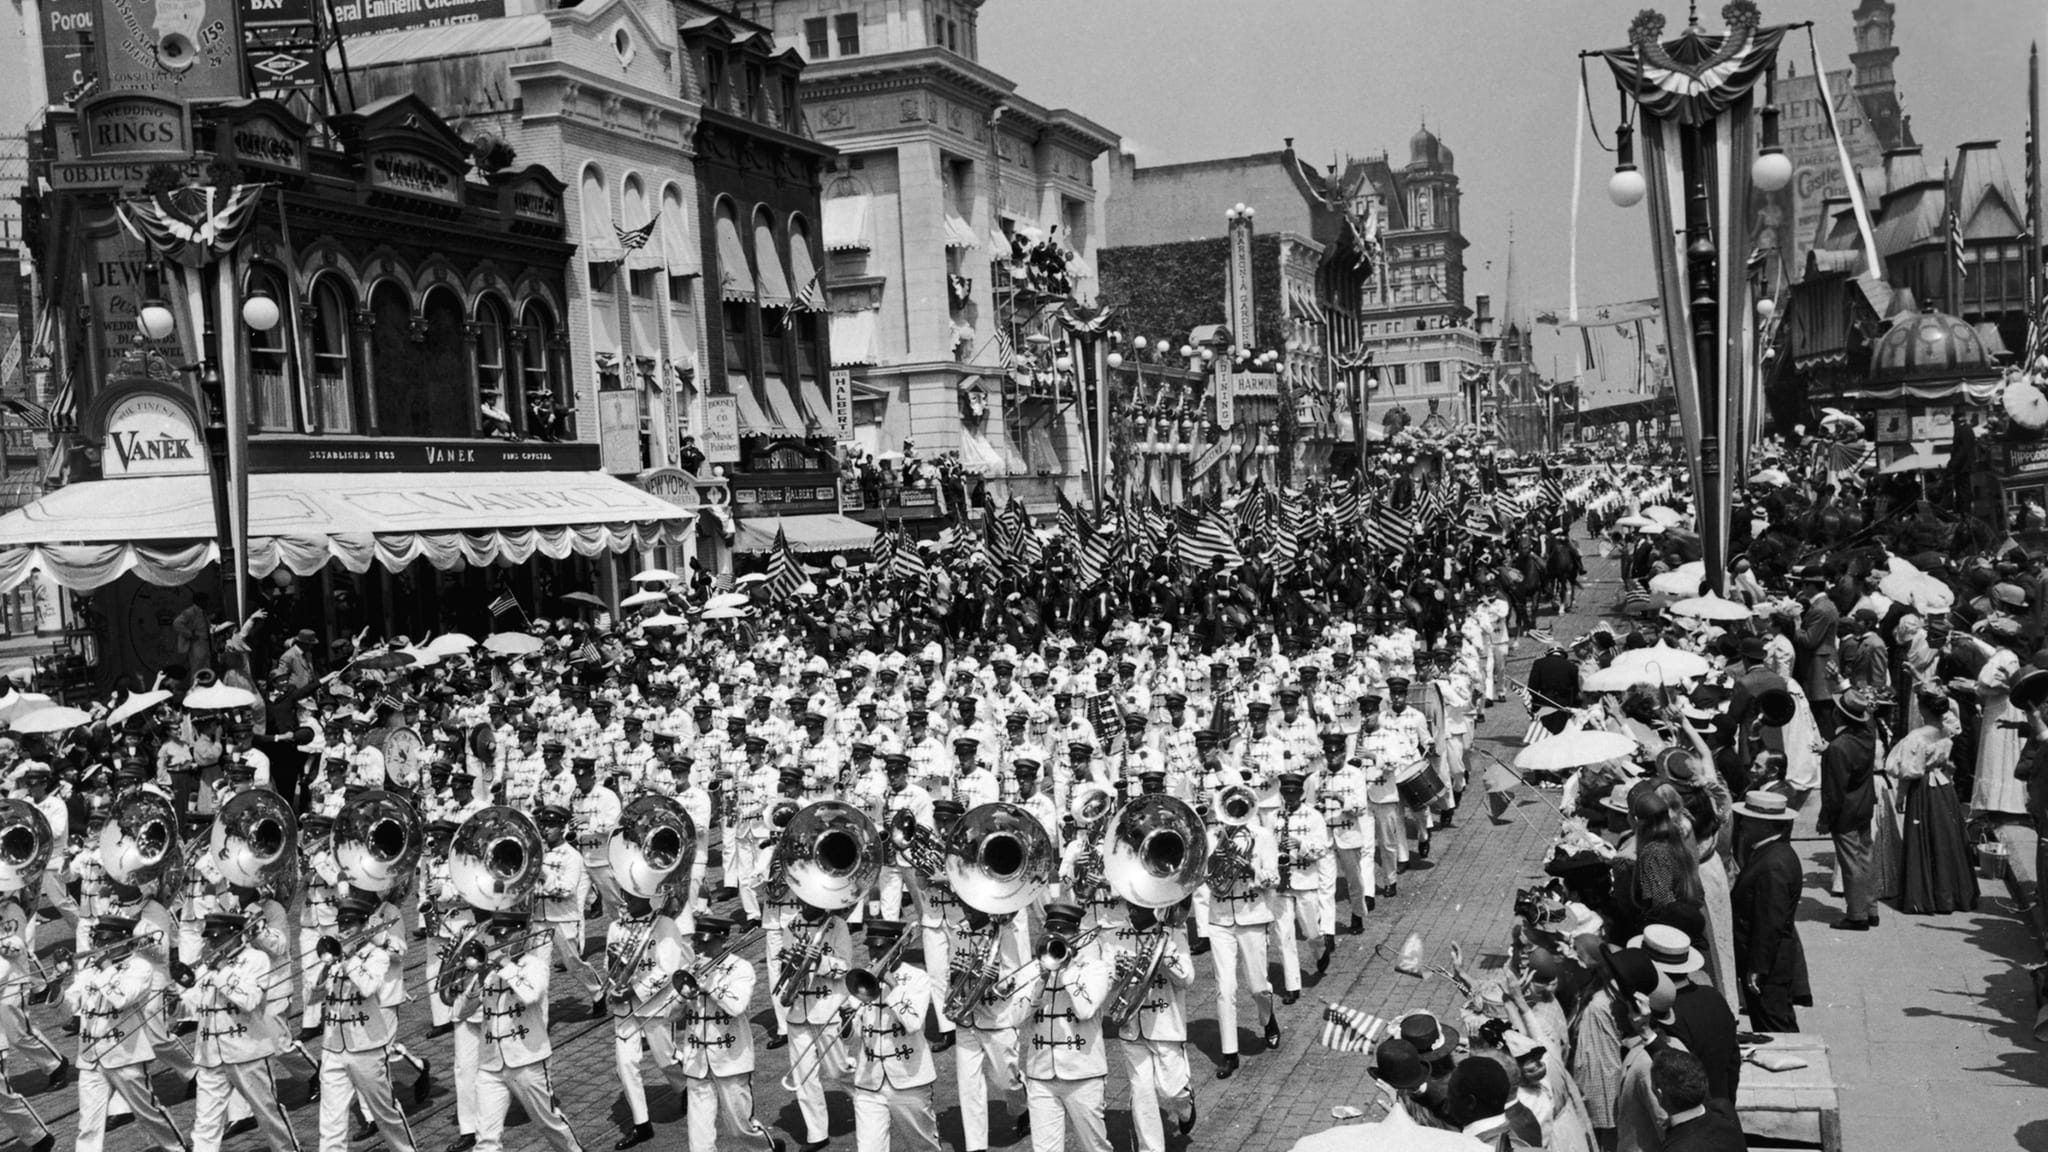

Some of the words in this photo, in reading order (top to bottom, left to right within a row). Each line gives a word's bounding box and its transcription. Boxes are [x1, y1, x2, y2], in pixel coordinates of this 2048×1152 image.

[202, 21, 225, 44] 159
[98, 121, 174, 146] RINGS
[63, 165, 144, 184] OBJECTS
[1220, 364, 1229, 419] DINING
[835, 378, 848, 430] HALBERT
[425, 446, 475, 465] VANEK
[644, 475, 663, 496] NEW
[663, 474, 690, 496] YORK
[784, 486, 814, 504] HALBERT
